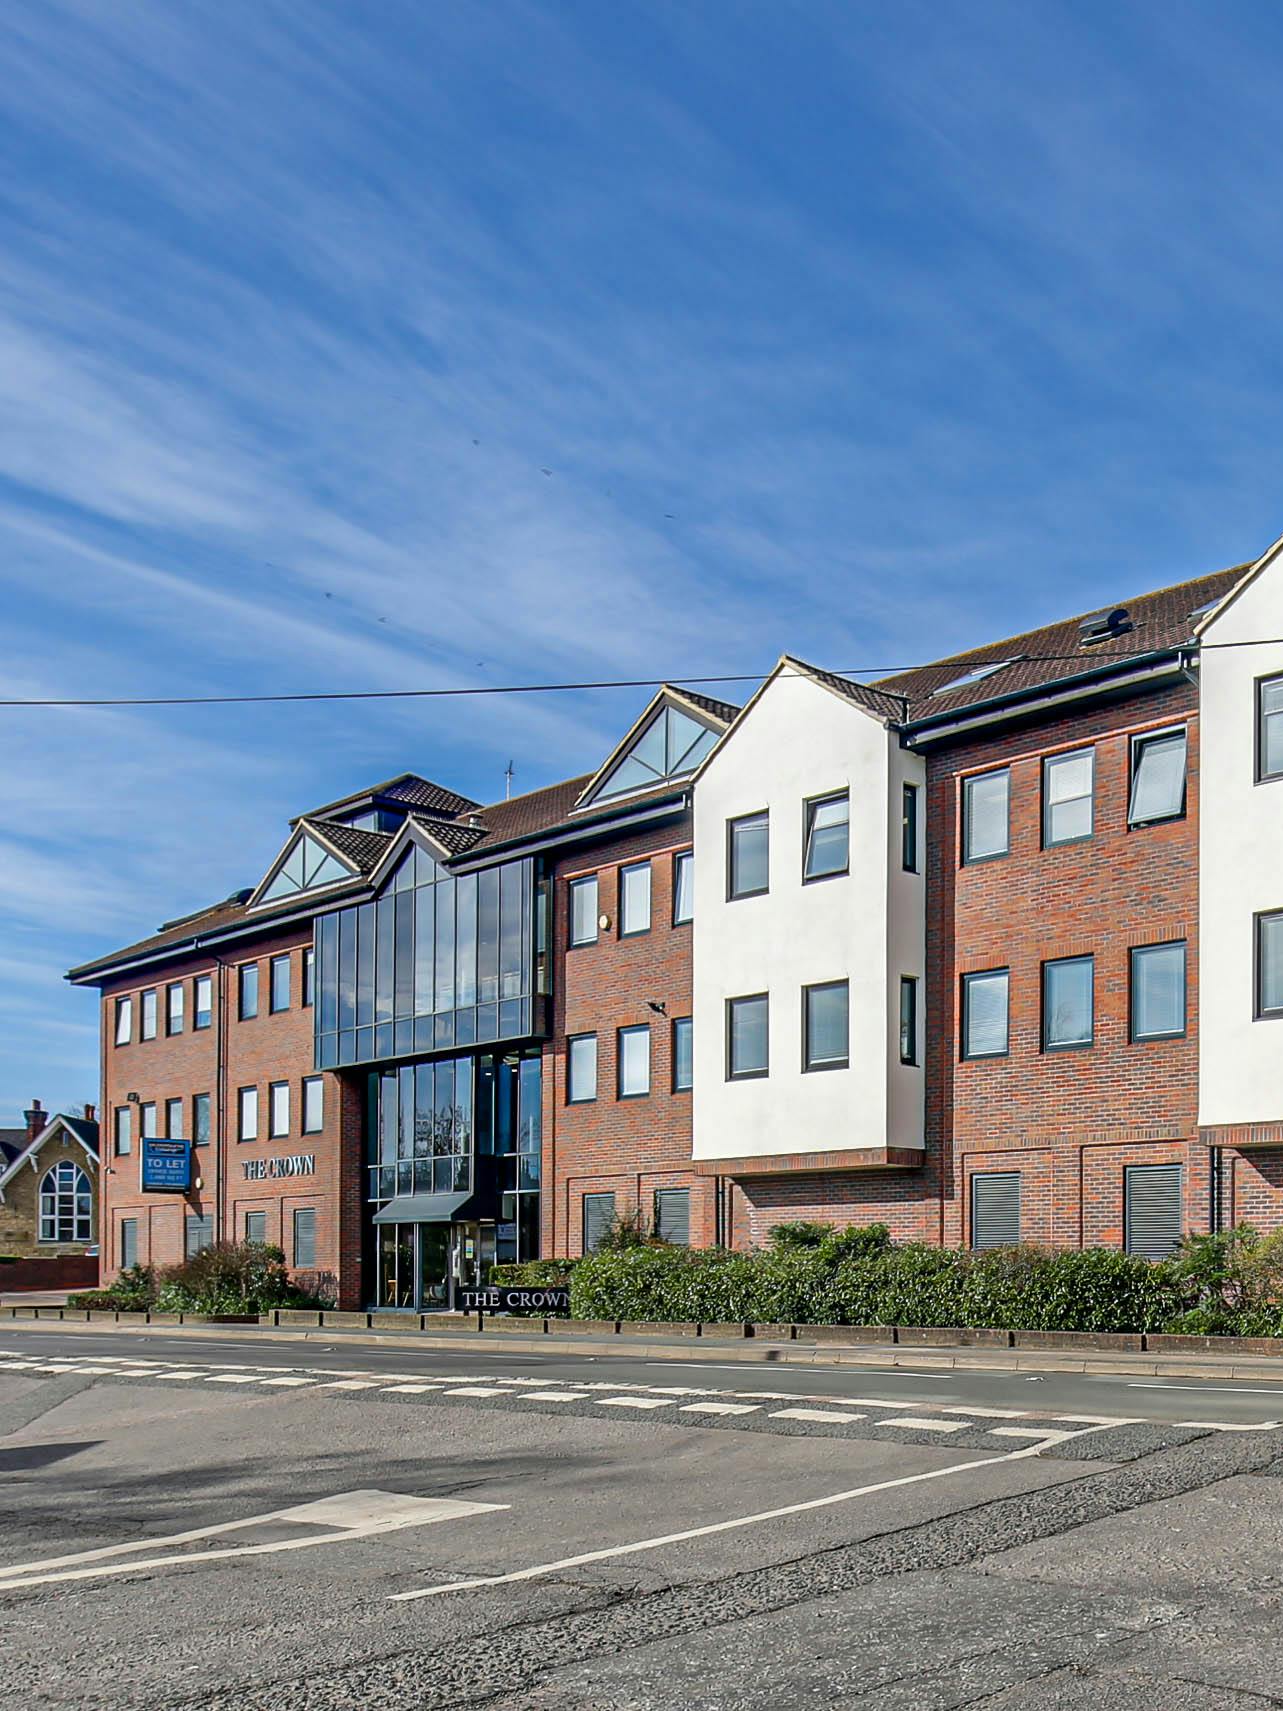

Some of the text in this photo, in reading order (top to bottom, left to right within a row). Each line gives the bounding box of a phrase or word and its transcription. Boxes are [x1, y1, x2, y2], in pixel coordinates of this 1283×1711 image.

[146, 1158, 186, 1169] TO LET
[240, 1154, 315, 1180] THE CROWN
[462, 1292, 500, 1307] THE
